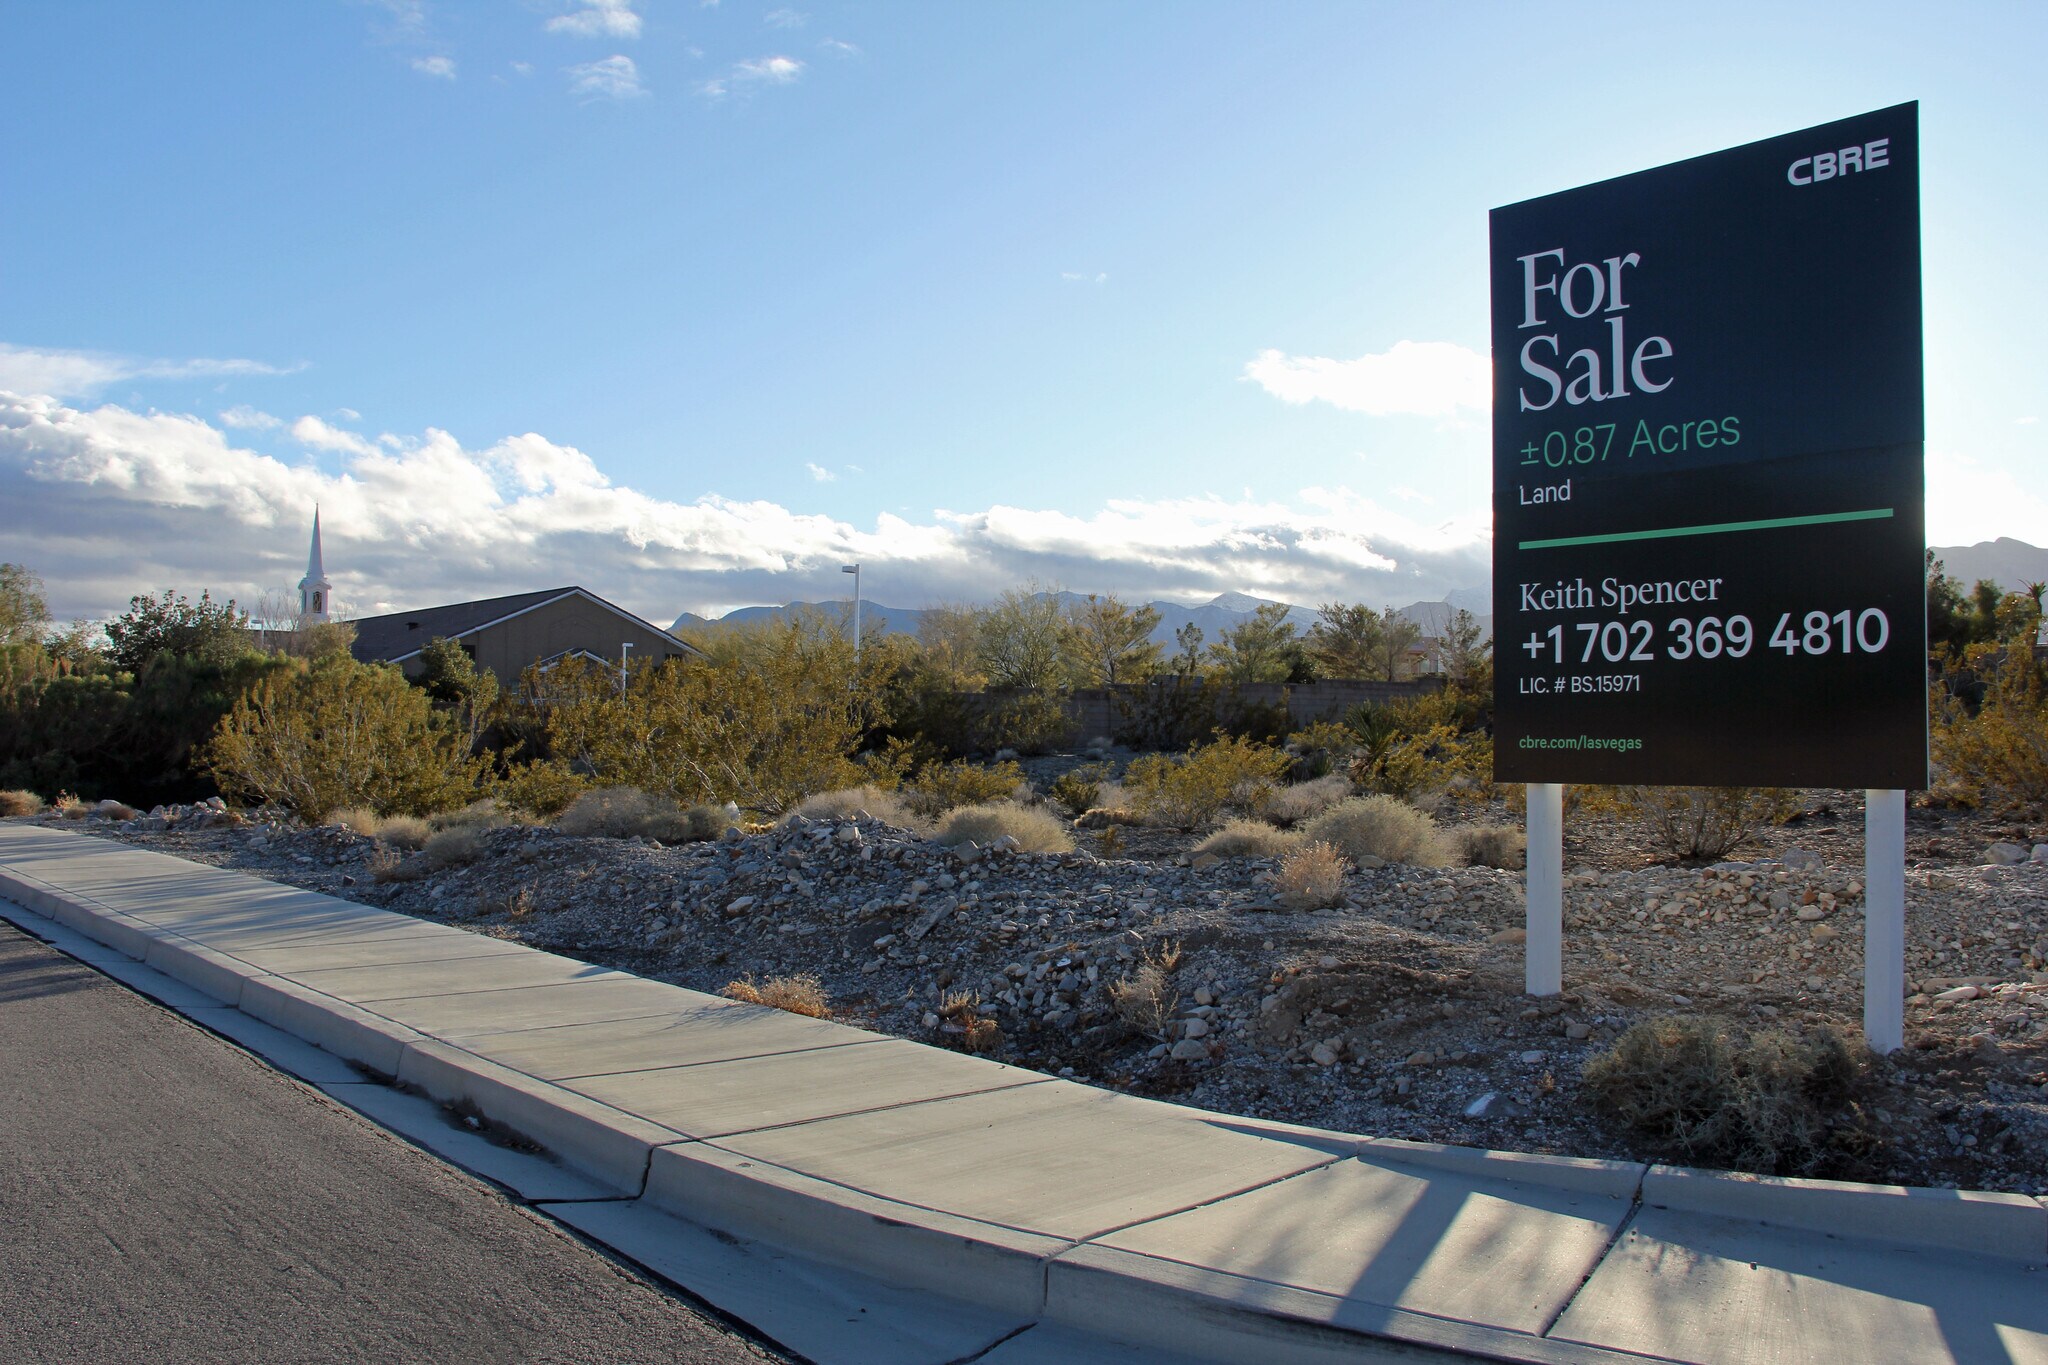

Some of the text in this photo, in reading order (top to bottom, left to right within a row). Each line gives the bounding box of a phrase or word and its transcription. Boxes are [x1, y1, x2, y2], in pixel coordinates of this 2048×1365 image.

[1787, 138, 1889, 186] CBRE
[1517, 248, 1640, 328] For
[1520, 316, 1673, 412] Sale
[1521, 417, 1739, 467] ±0.87 Acres
[1520, 479, 1570, 505] Land
[1519, 577, 1722, 614] Keith Spencer
[1523, 608, 1890, 663] +1 702 369 4810
[1520, 675, 1639, 693] LIC. # BS.15971
[1519, 735, 1641, 752] cbre.com/lasvegas
